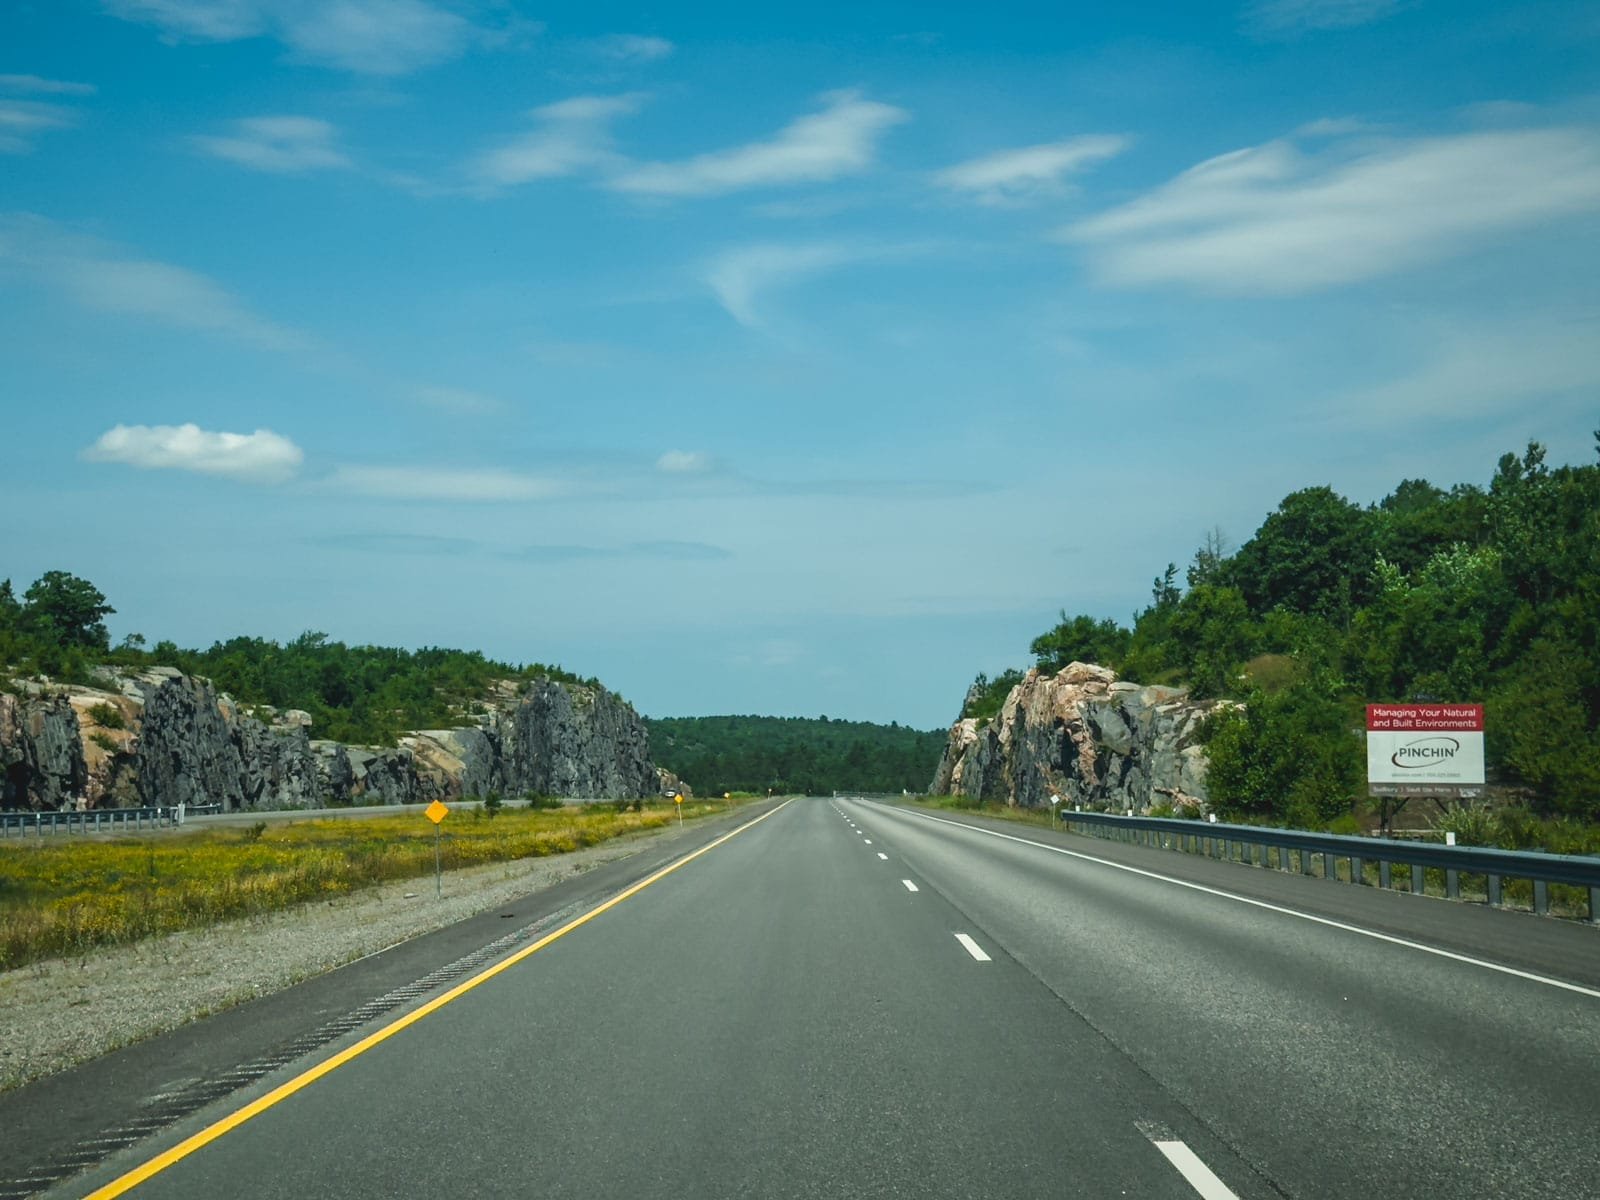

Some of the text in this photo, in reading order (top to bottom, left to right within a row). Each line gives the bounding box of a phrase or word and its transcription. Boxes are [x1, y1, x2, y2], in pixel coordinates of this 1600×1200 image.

[1373, 709, 1476, 718] Managing Your Natural
[1373, 719, 1477, 727] and Built Environments
[1399, 748, 1454, 757] PINCHIN
